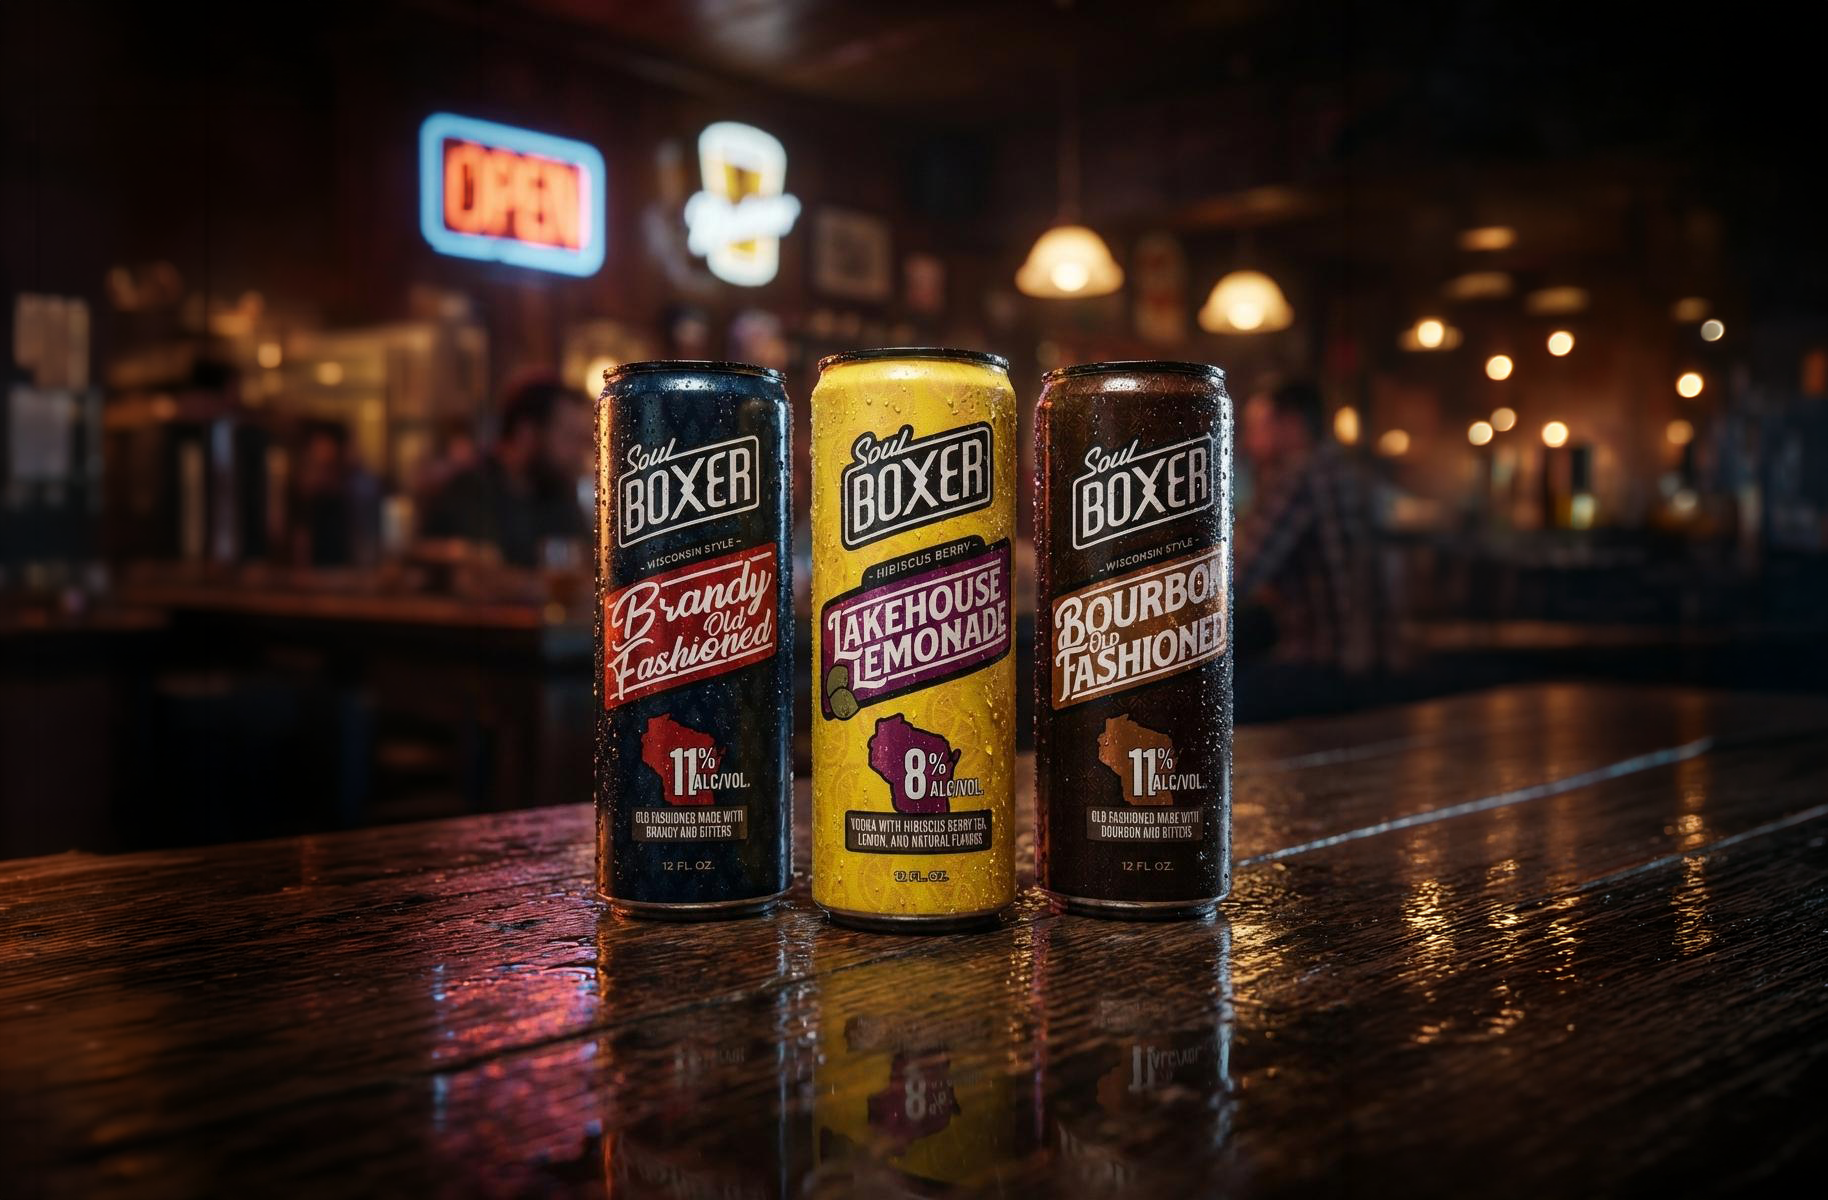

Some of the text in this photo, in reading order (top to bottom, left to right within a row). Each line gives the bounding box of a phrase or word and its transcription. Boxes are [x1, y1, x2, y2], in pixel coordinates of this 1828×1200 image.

[444, 139, 584, 252] OPEN
[626, 437, 676, 474] Soul
[855, 429, 909, 467] Soul
[1084, 439, 1138, 476] Soul
[625, 447, 751, 536] BOXER
[853, 438, 983, 533] BOXER
[1082, 447, 1207, 538] BOXER
[704, 538, 734, 553] STYLE
[876, 541, 970, 580] HIBISCUS BERRY
[1165, 537, 1193, 553] STYLE
[608, 560, 772, 651] Brandy
[703, 606, 746, 636] Old
[827, 566, 1001, 664] LAKEHOUSE
[608, 608, 772, 701] Fashioned
[852, 600, 1006, 690] LEMONADE
[1055, 611, 1226, 702] FASHIONED
[879, 819, 901, 833] WITH
[662, 861, 674, 871] 12
[1122, 861, 1134, 871] 12
